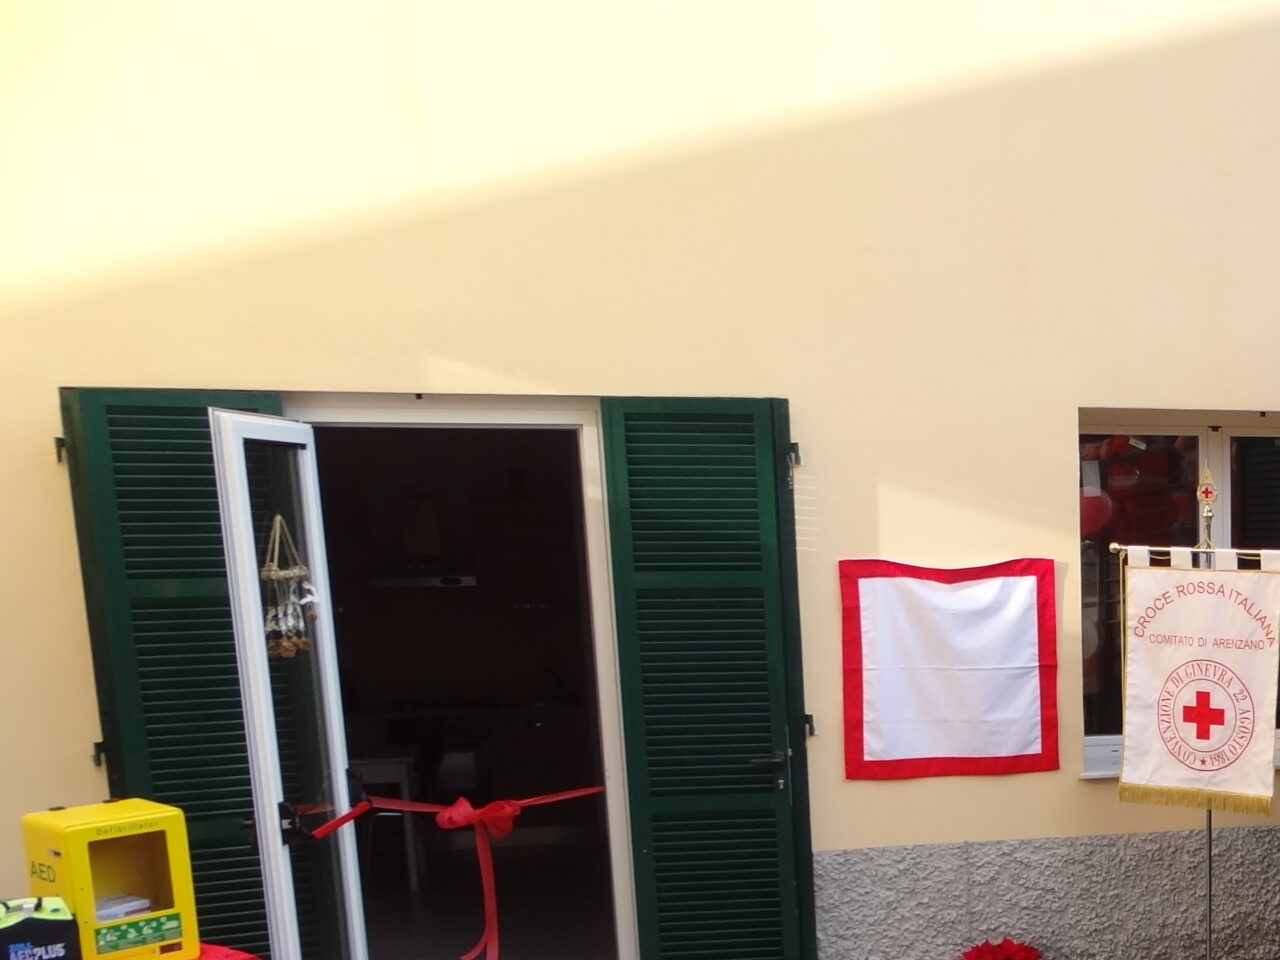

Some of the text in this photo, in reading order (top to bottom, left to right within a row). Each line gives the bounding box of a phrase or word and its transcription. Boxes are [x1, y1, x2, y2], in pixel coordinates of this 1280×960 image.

[1134, 581, 1277, 648] CROCE ROSSA ITALIANA
[1149, 633, 1265, 650] COMITATO DI ARENZANO
[1160, 662, 1252, 768] CONVENZIONE DI GINEVRA 22 AGOSTO 1864
[30, 861, 56, 883] AED
